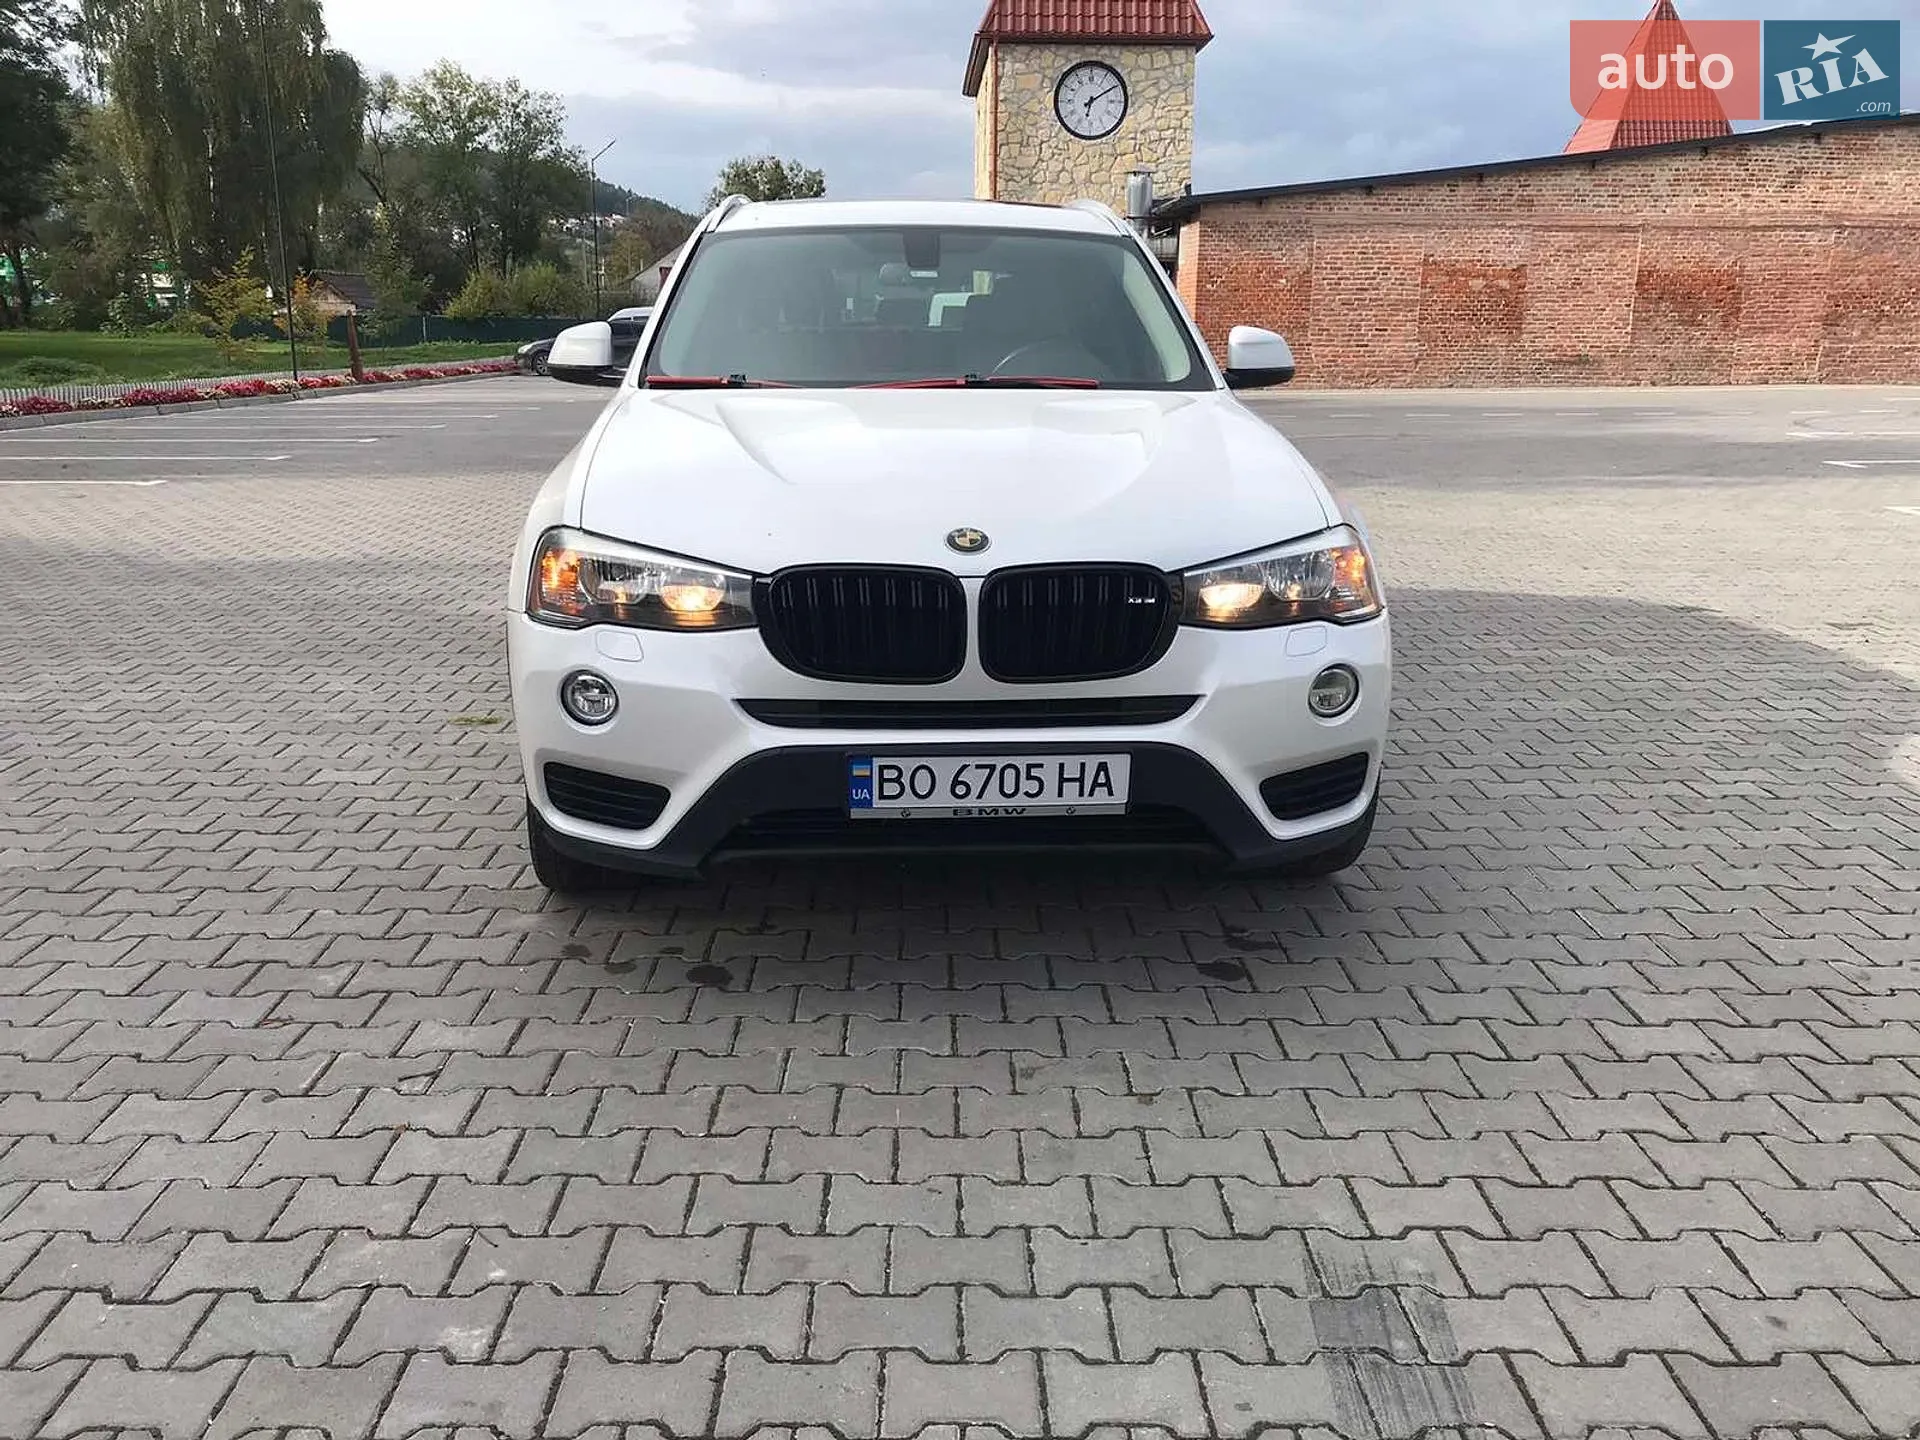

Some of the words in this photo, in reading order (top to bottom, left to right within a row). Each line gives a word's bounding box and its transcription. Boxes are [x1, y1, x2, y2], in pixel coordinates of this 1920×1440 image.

[878, 764, 937, 801] BO
[950, 762, 1045, 800] 6705
[1057, 761, 1114, 798] HA
[852, 788, 871, 801] UA
[953, 806, 1026, 816] BMW
